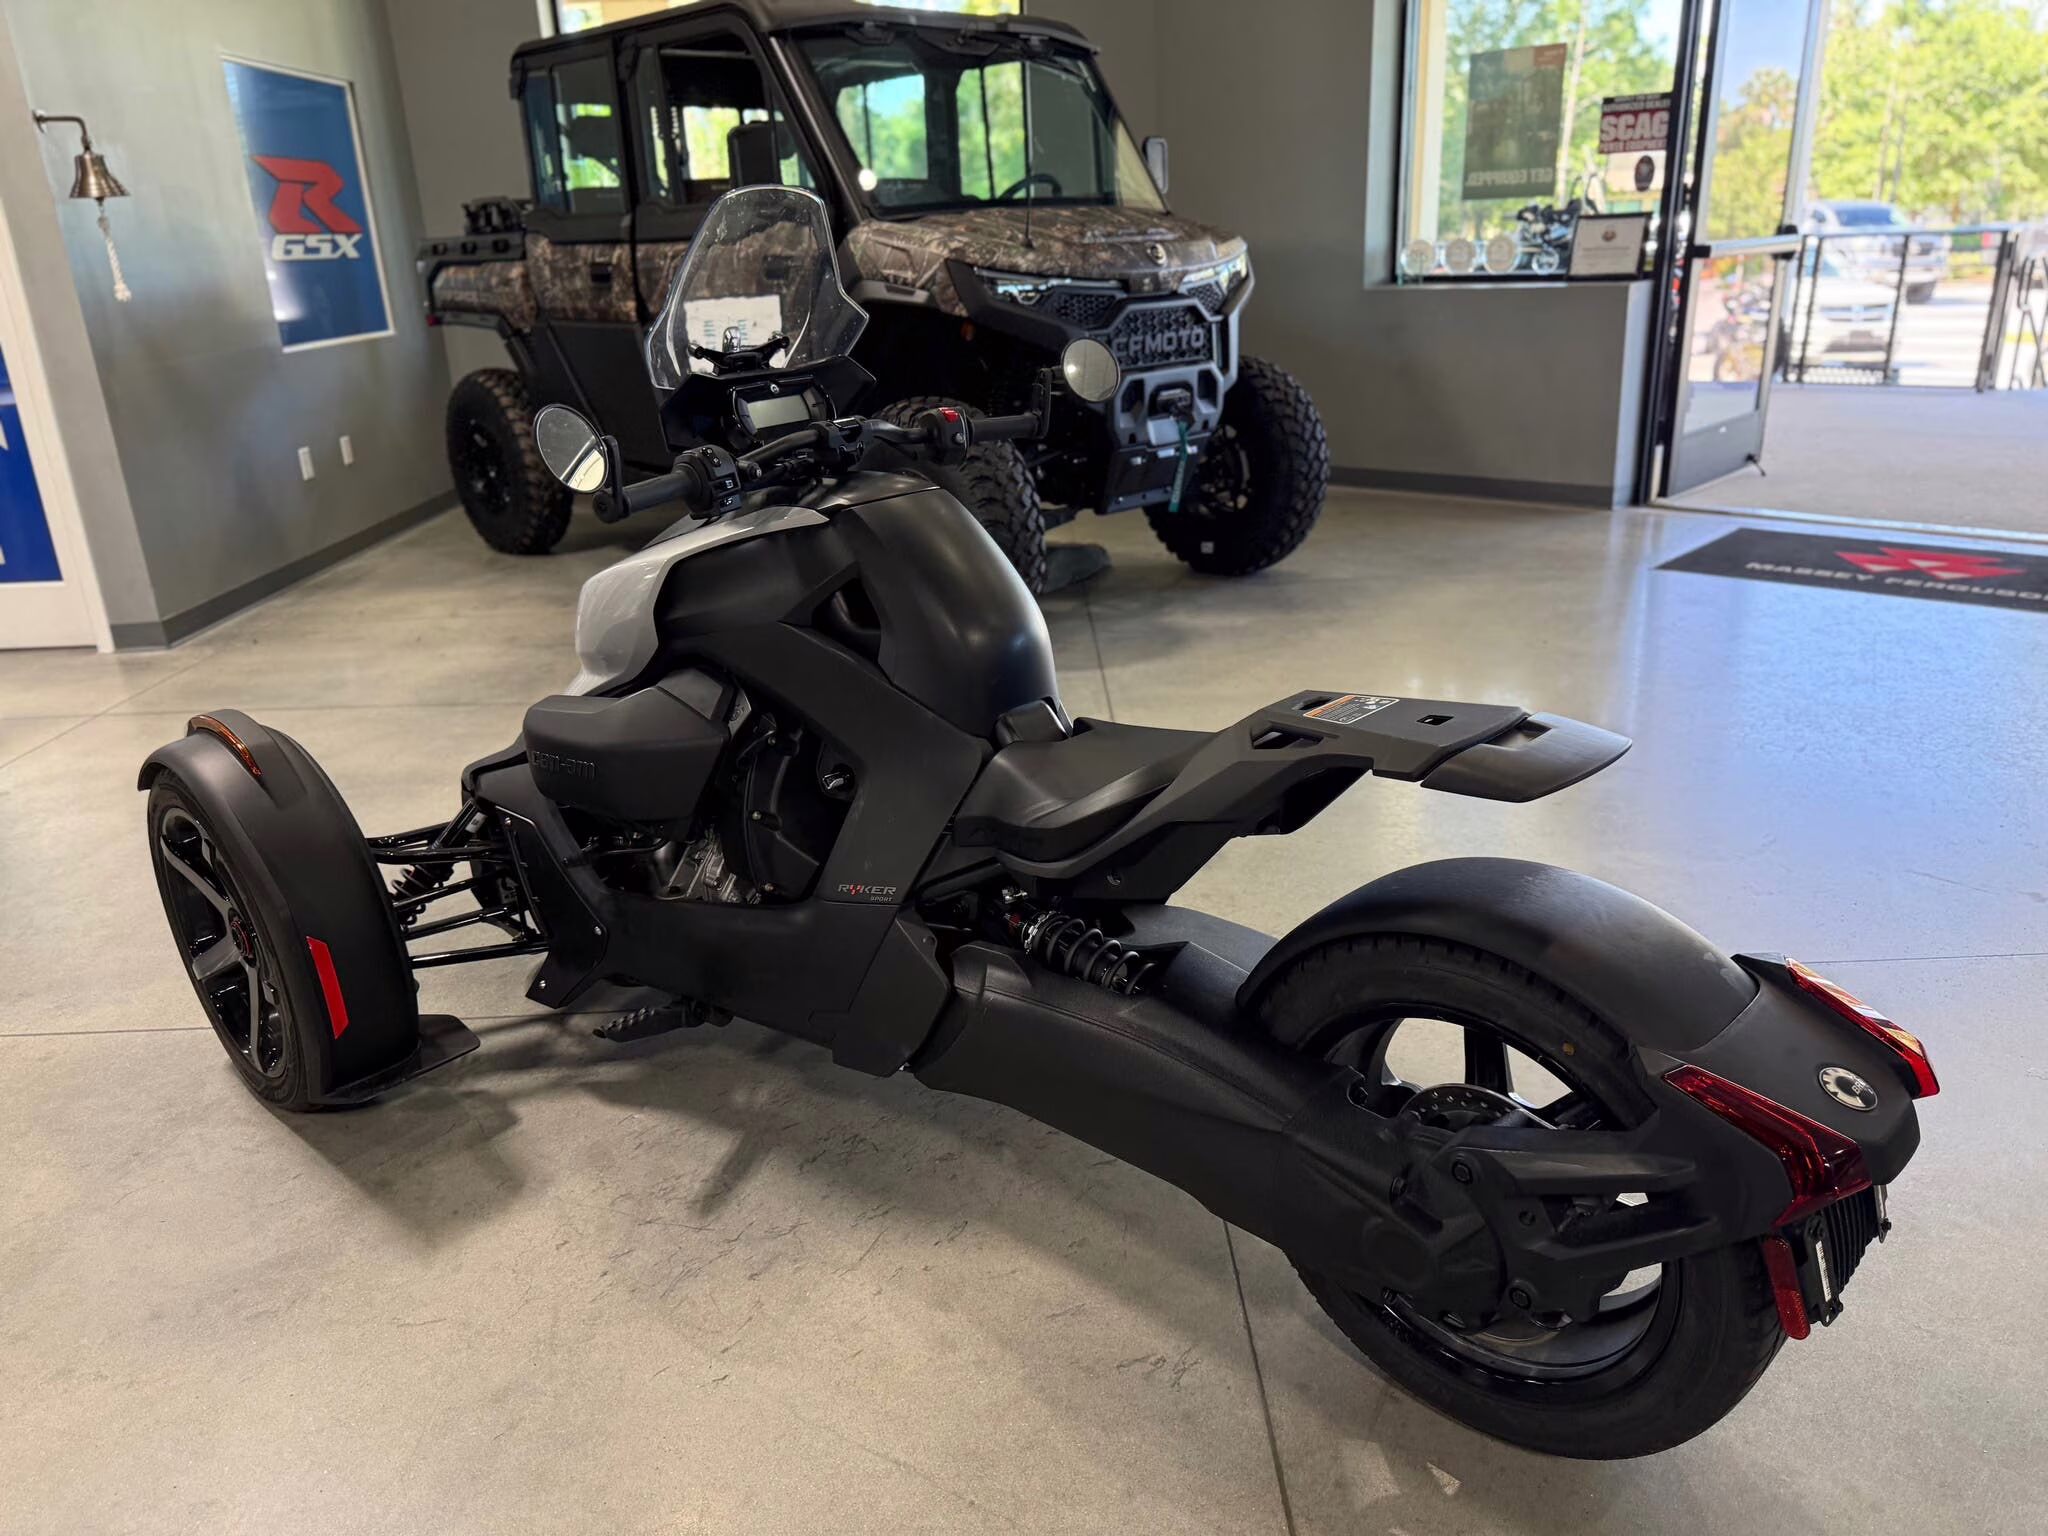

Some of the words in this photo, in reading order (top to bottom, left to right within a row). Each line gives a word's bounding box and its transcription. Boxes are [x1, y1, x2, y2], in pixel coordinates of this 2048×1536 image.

[1600, 110, 1669, 141] SCAG
[272, 233, 362, 260] GSX
[1112, 325, 1205, 357] CFMOTO
[1745, 561, 1874, 582] MASSEY
[1884, 576, 2048, 601] FERGUSO
[838, 884, 897, 896] RYKER
